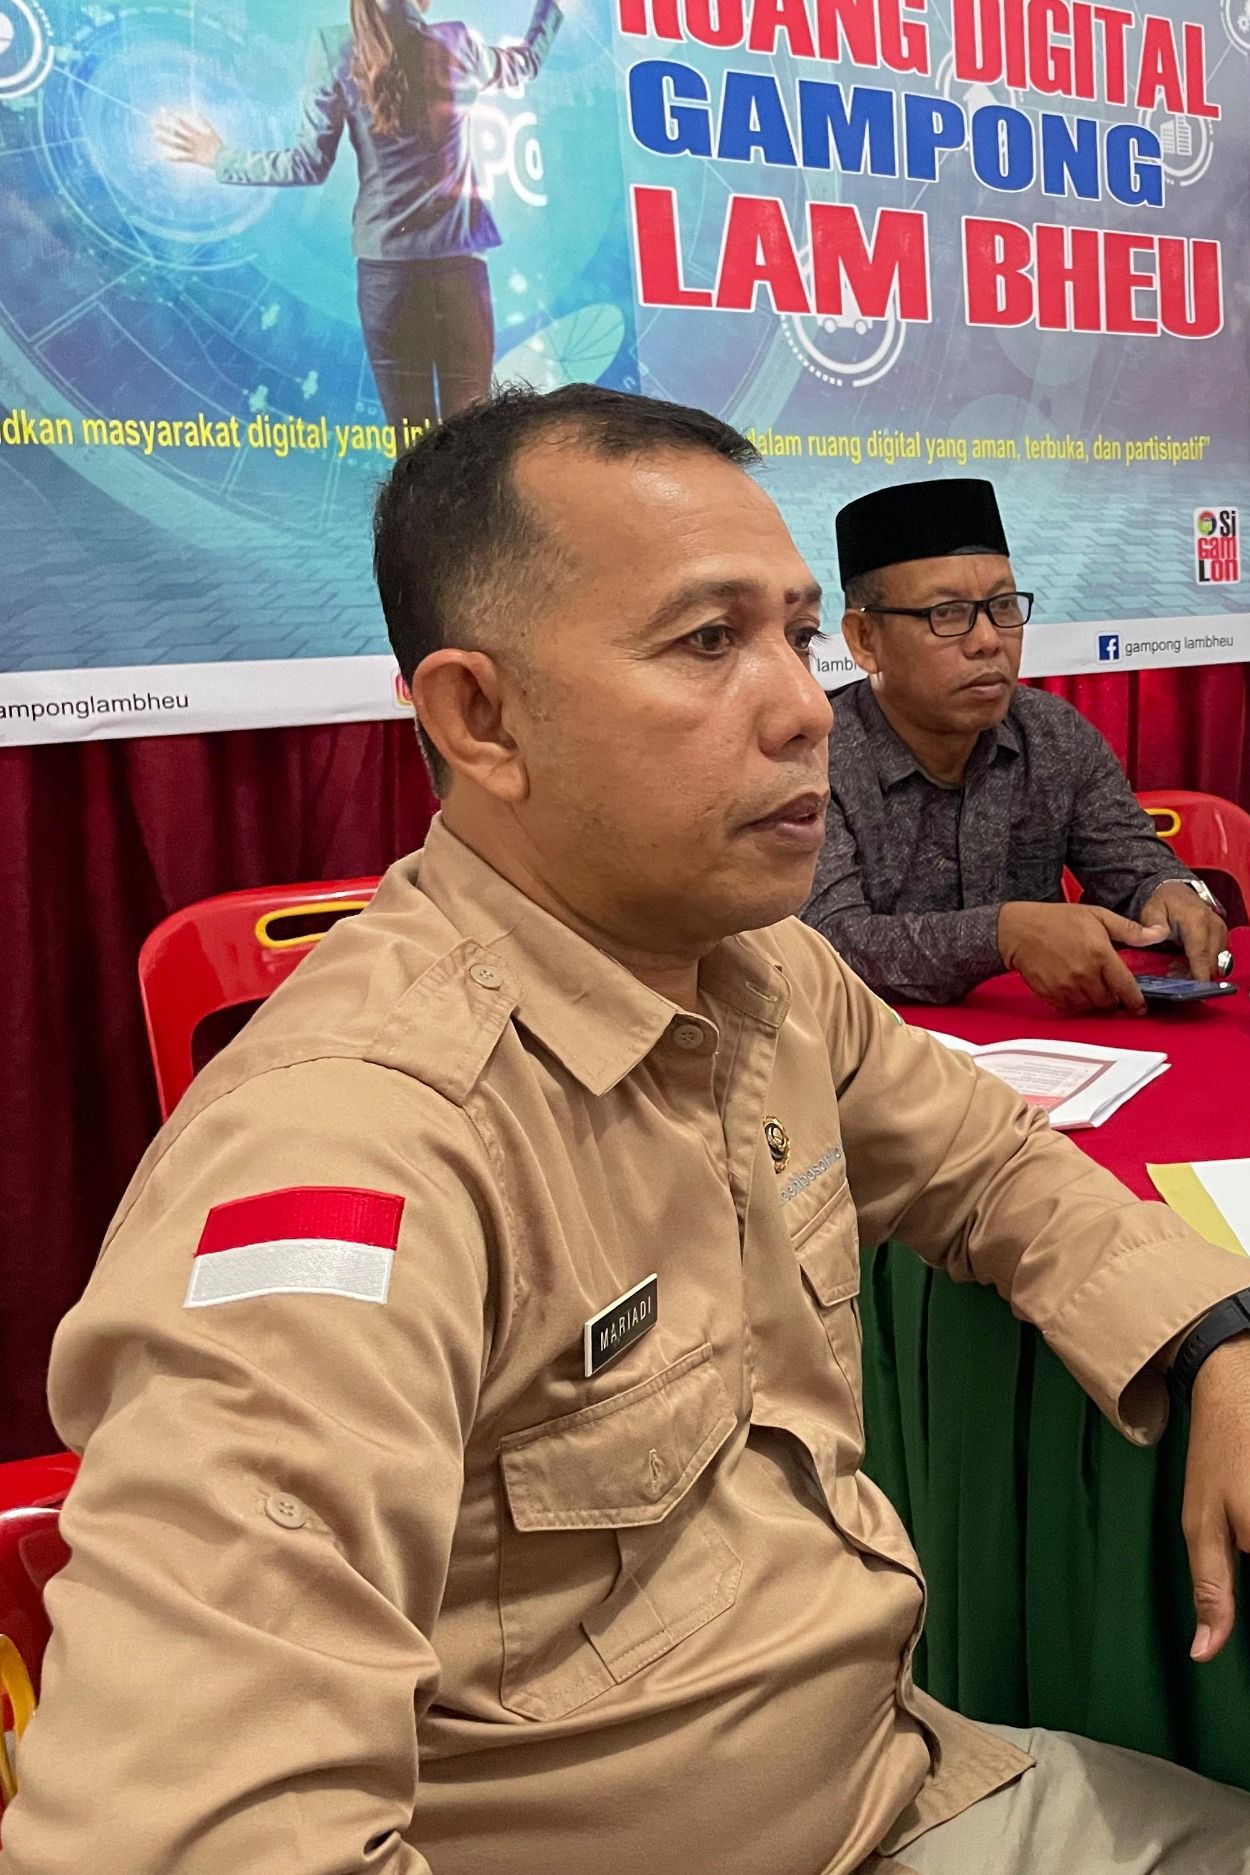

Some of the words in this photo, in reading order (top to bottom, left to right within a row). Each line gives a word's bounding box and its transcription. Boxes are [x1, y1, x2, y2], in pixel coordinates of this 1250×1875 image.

[951, 0, 1221, 119] DIGITAL
[628, 59, 1165, 208] GAMPONG
[629, 184, 933, 322] LAM
[961, 214, 1225, 340] BHEU
[0, 409, 74, 446] dkan
[82, 413, 240, 455] masyarakat
[247, 415, 327, 457] digital
[335, 424, 397, 458] yang
[807, 433, 861, 465] ruang
[867, 430, 921, 465] digital
[926, 438, 968, 466] yang
[971, 438, 1021, 463] aman,
[1025, 433, 1089, 463] terbuka,
[1093, 435, 1121, 460] dan
[1219, 510, 1236, 537] Si
[1125, 639, 1181, 657] gampong
[1184, 634, 1234, 649] lambheu
[600, 1295, 651, 1351] MARIADI
